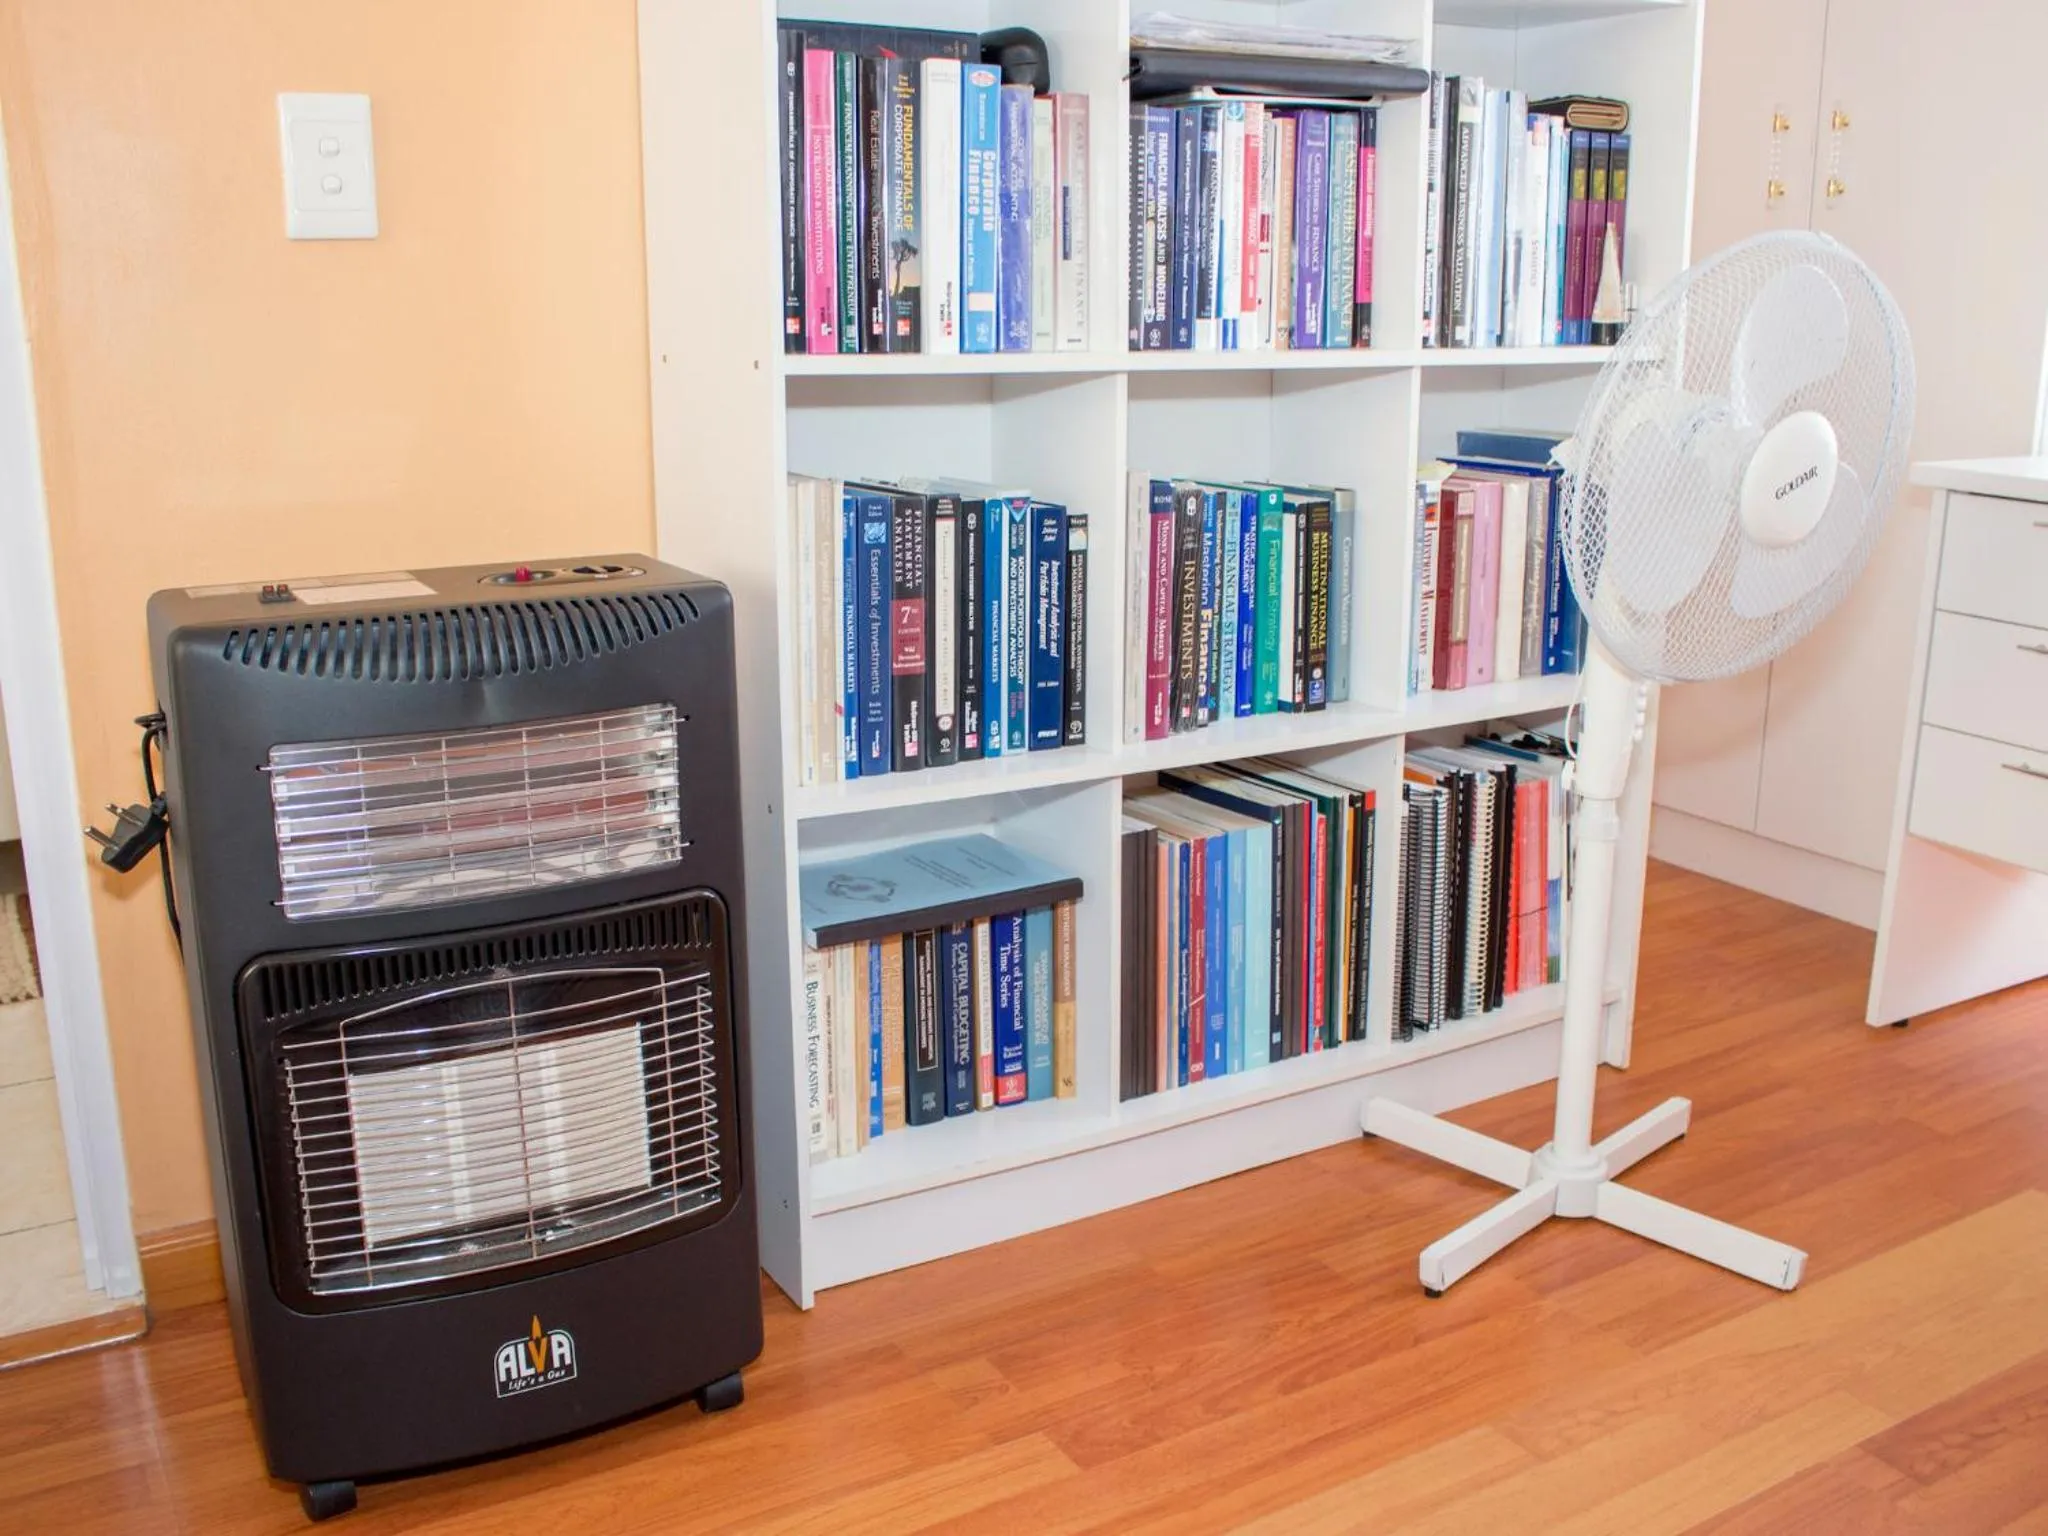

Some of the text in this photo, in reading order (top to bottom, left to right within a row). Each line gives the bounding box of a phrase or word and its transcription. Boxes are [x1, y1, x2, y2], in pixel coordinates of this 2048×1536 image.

[844, 102, 853, 153] FINANCIAL
[813, 136, 823, 199] INSTRUMENTS
[844, 156, 853, 207] PLANNING
[870, 109, 881, 280] Real Estate Investments
[894, 104, 904, 232] CORPORATE FINANCE
[903, 104, 914, 232] FUNDAMENTALS OF
[968, 149, 981, 216] Finance
[982, 150, 997, 232] Corporate
[815, 211, 825, 274] INSTITUTIONS
[1147, 200, 1156, 218] VBA
[1155, 132, 1169, 322] FINANCIAL ANALYSIS AND MODELING
[1340, 140, 1358, 329] CASE STUDIES IN FINANCE
[1453, 127, 1470, 311] ADVANCED BUSINESS VALUATION
[846, 245, 856, 317] ENTREPRENEUR
[1311, 226, 1321, 274] FINANCE
[1775, 465, 1818, 500] GOLDAIR
[894, 517, 903, 583] ANALYSIS
[904, 508, 914, 590] STATEMENT
[913, 510, 923, 586] FINANCIAL
[1159, 557, 1168, 575] AND
[1160, 519, 1170, 556] MONEY
[1214, 509, 1224, 564] Understanding
[1242, 532, 1251, 594] MANAGEMENT
[1248, 515, 1258, 610] STRATEGIC FINANCIAL
[1422, 526, 1438, 587] INVESTMENT
[1036, 561, 1050, 650] Portfolio Management
[1048, 560, 1061, 658] Investment Analysis and
[1158, 577, 1168, 616] CAPITAL
[1213, 565, 1222, 588] South
[1264, 539, 1281, 652] Financial Strategy
[1310, 531, 1320, 650] BUSINESS FINANCE
[1318, 531, 1329, 649] MULTINATIONAL
[847, 604, 856, 651] FINANCIAL
[869, 548, 882, 695] Essentials of Investments
[991, 600, 1000, 684] FINANCIAL MARKETS
[1008, 556, 1018, 677] AND INVESTMENT ANALYSIS
[1016, 556, 1026, 685] MODERN PORTFOLIO THEORY
[1157, 618, 1167, 662] MARKETS
[1181, 559, 1197, 680] INVESTMENTS
[1199, 609, 1213, 697] Finance
[1222, 540, 1238, 695] FINANCIAL STRATEGY
[1418, 589, 1436, 656] MANAGEMENT
[846, 653, 856, 693] MARKETS
[1211, 651, 1219, 684] Markets
[957, 942, 971, 1066] CAPITAL BUDGETING
[999, 943, 1011, 1009] Time Series
[1010, 917, 1024, 1031] Analysis of Financial
[806, 981, 821, 1109] BUSINESS FORECASTING
[498, 1333, 572, 1382] ALVA
[509, 1377, 536, 1390] Life's
[547, 1368, 566, 1380] Gas
